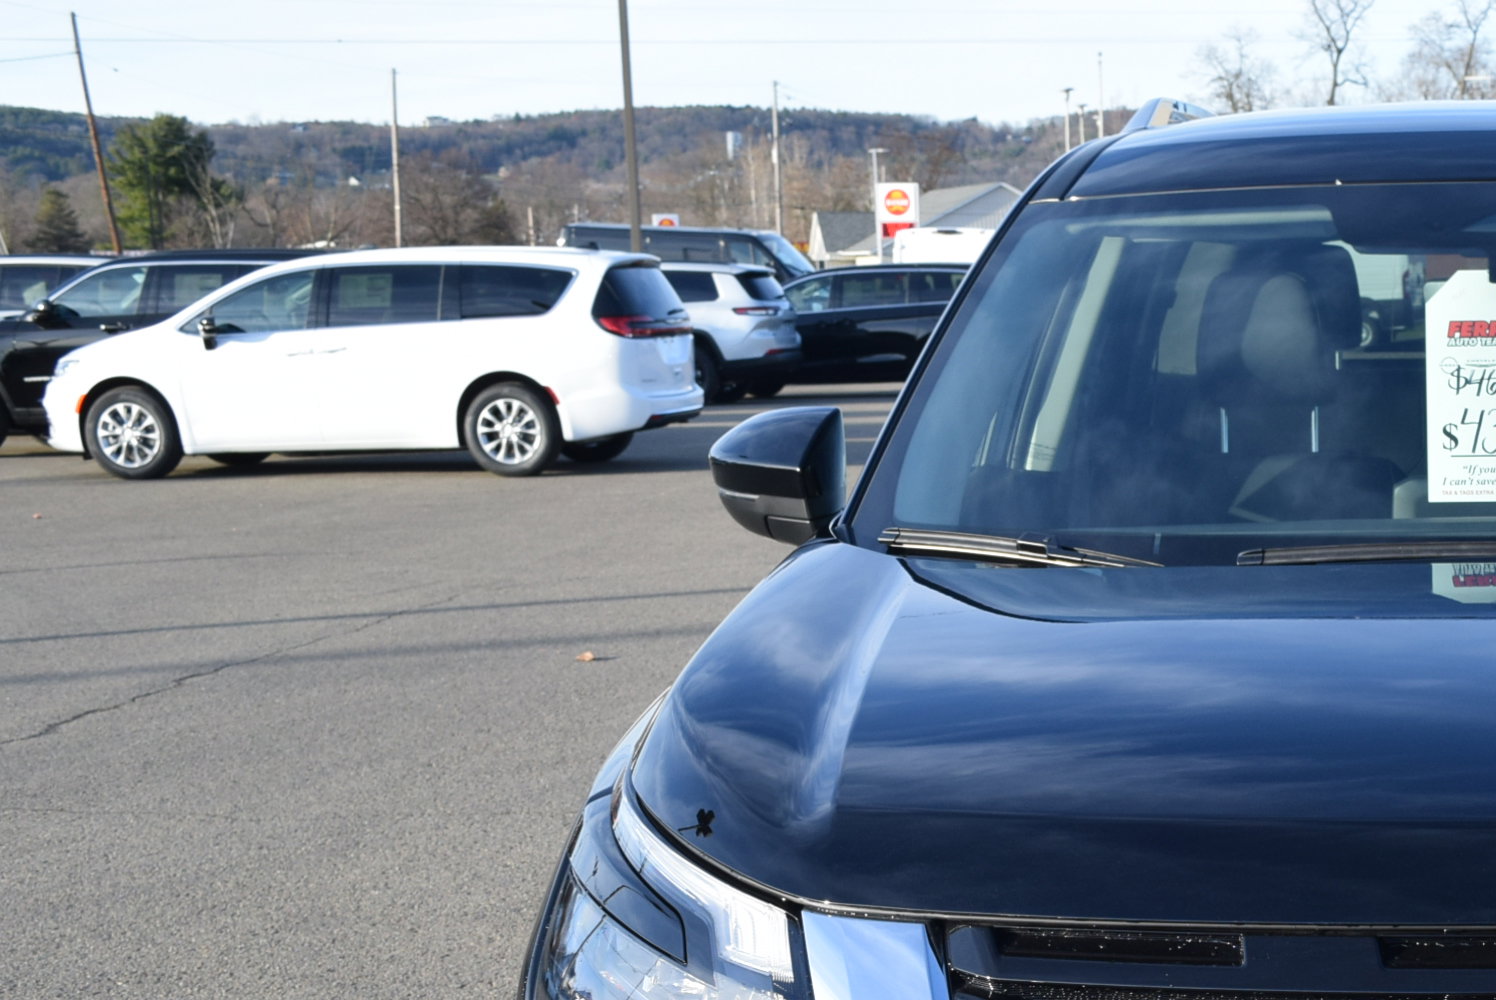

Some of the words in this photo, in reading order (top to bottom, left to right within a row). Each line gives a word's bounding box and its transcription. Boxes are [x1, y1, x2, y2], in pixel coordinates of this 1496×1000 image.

[1447, 336, 1478, 347] AUTO
[1478, 467, 1496, 476] you
[1449, 477, 1474, 486] can't
[1475, 478, 1496, 486] save
